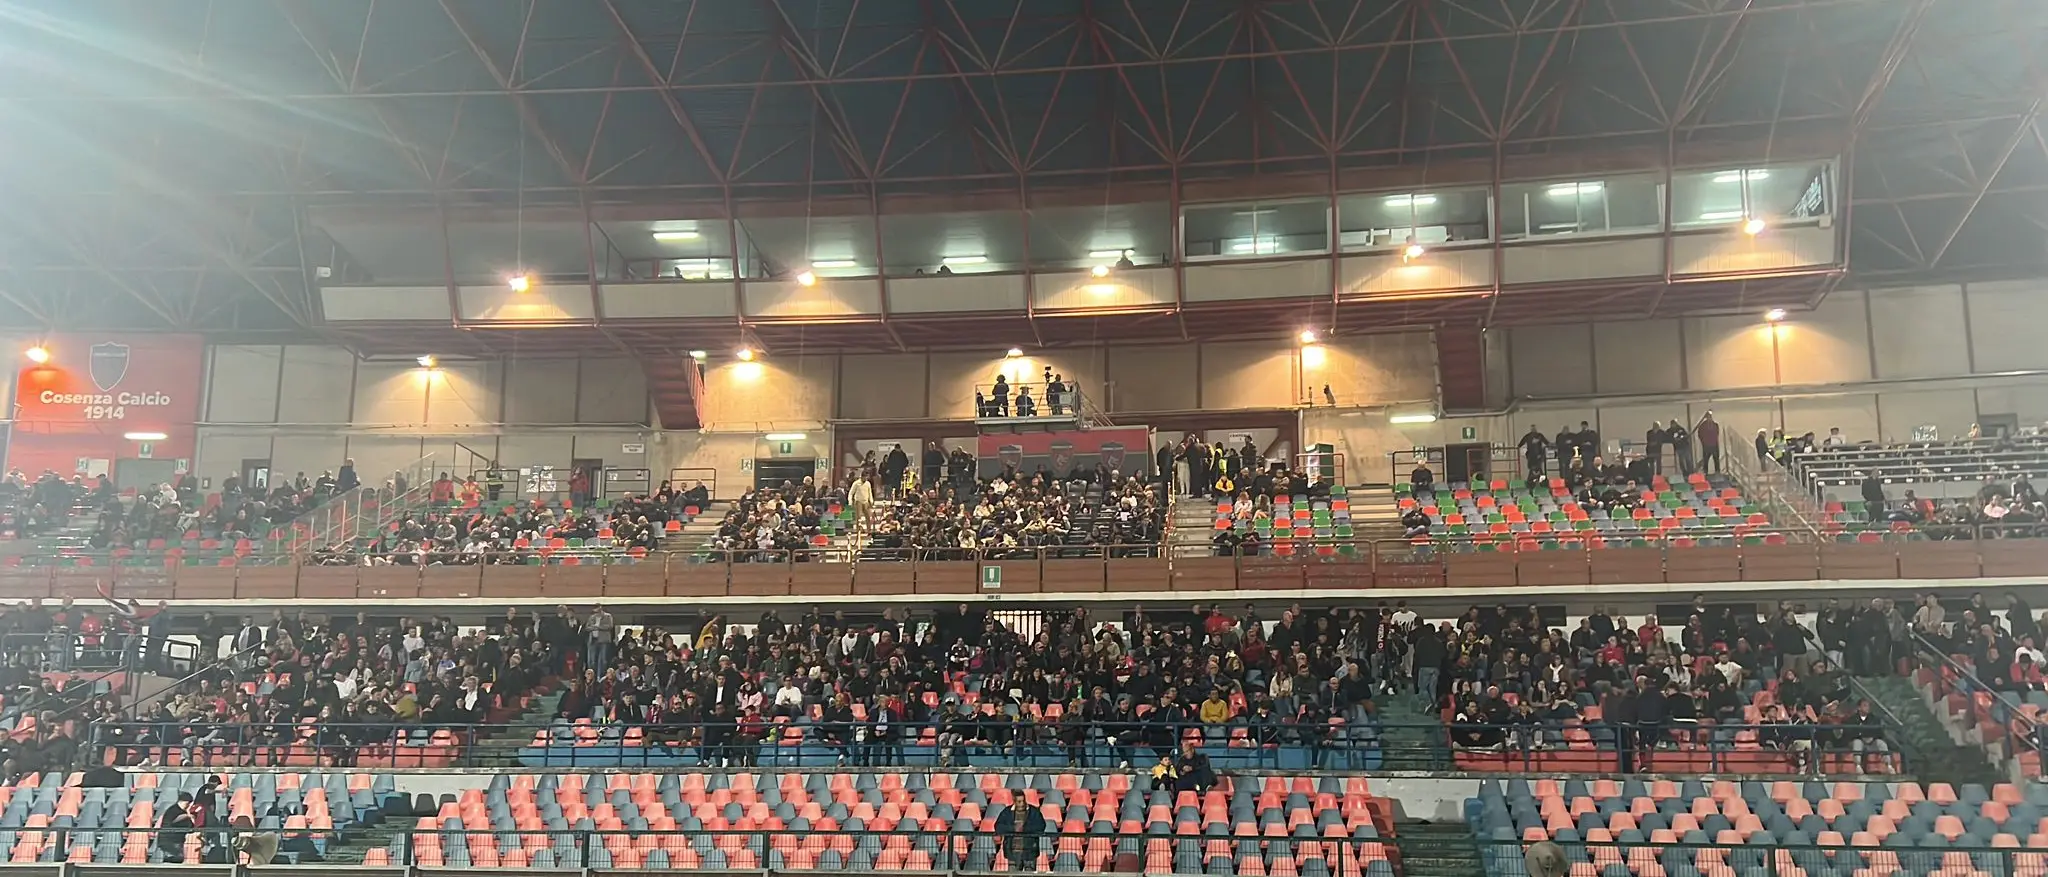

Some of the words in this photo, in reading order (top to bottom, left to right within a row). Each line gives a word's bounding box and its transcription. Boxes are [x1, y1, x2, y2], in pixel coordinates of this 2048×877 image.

[40, 390, 113, 404] Cosenza
[118, 391, 171, 405] Calcio
[84, 406, 125, 419] 1914
